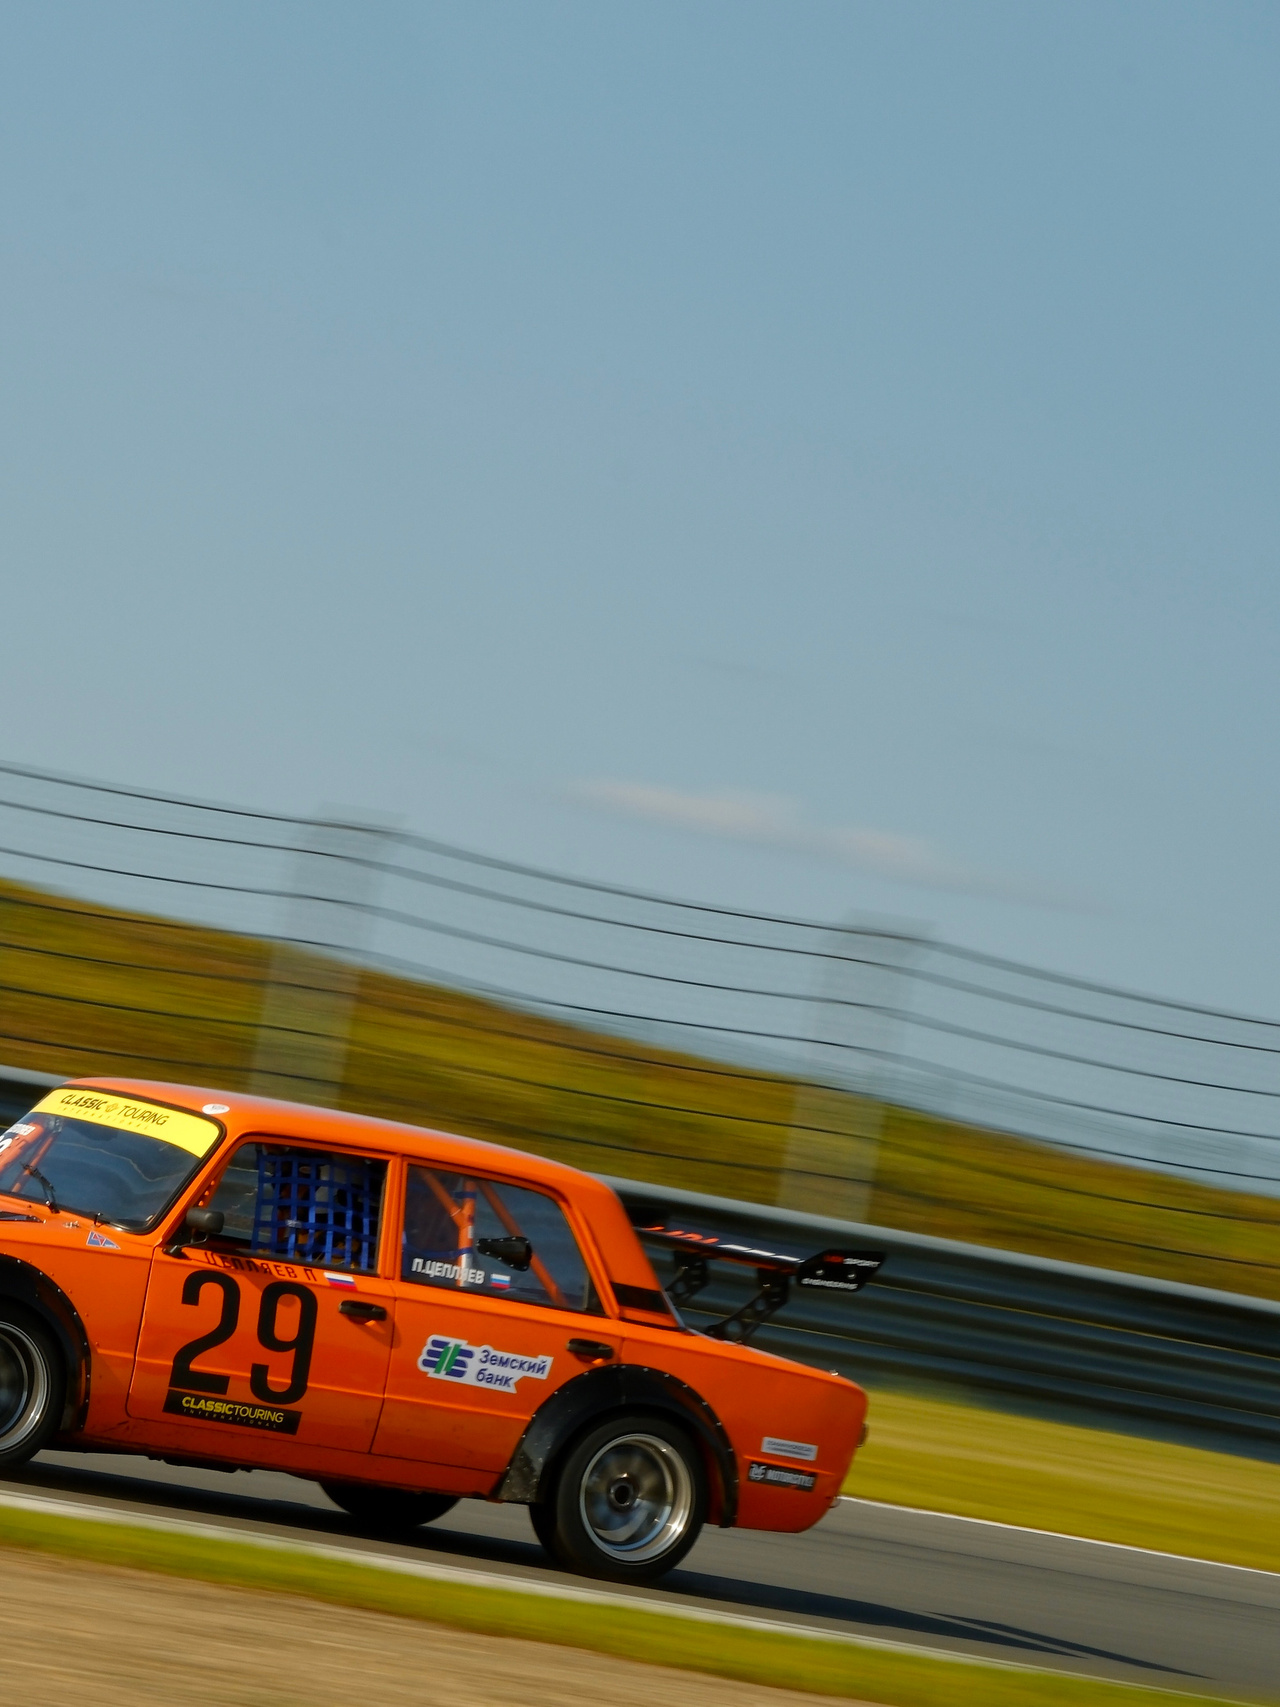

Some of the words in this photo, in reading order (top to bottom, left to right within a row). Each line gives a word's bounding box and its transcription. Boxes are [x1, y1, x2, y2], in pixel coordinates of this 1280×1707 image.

[60, 1094, 108, 1110] CLASSIC
[117, 1105, 170, 1126] TOURING
[169, 1269, 318, 1405] 29
[479, 1349, 549, 1375] Земский
[476, 1368, 515, 1388] банк
[183, 1408, 278, 1429] INTERNATIONAL
